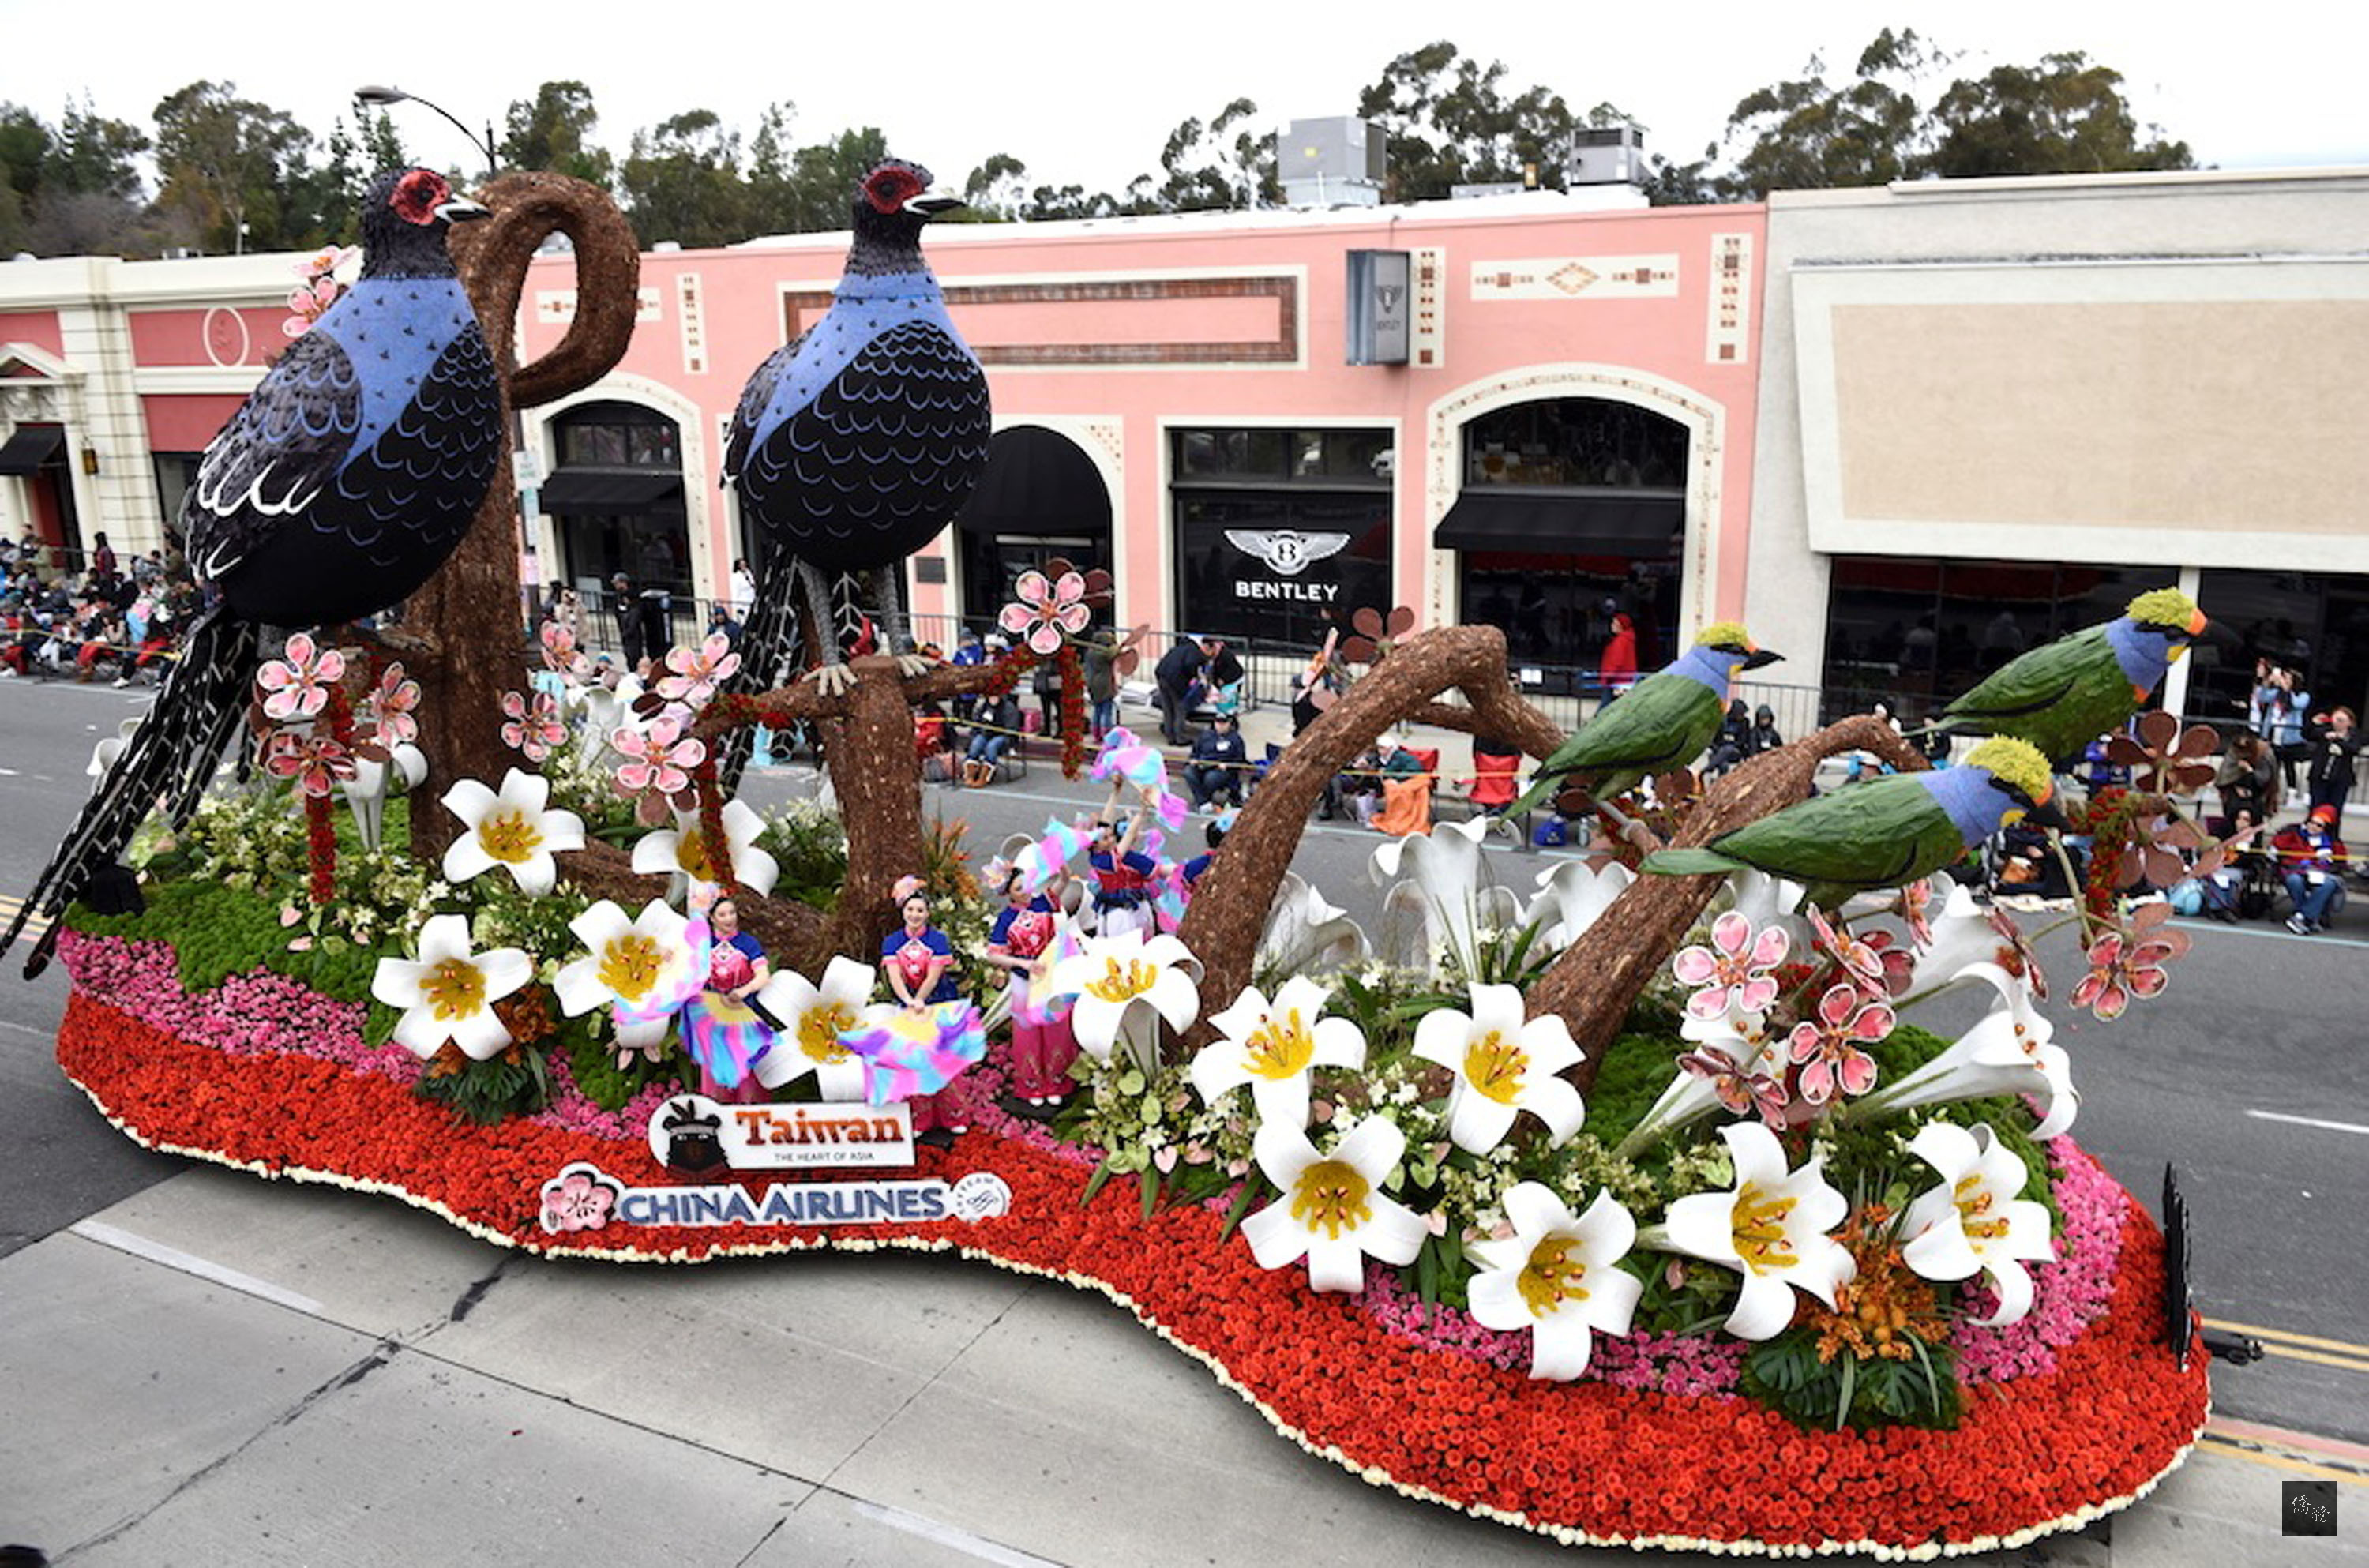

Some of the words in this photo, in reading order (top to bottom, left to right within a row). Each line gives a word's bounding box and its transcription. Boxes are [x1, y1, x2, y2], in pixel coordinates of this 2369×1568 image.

[1235, 580, 1338, 602] BENTLEY
[735, 1108, 904, 1146] Taiwan
[774, 1153, 794, 1162] THE
[797, 1152, 831, 1161] HEART
[833, 1151, 847, 1161] OF
[850, 1151, 875, 1161] ASIA
[621, 1191, 757, 1223] CHINA
[763, 1187, 945, 1221] AIRLINES
